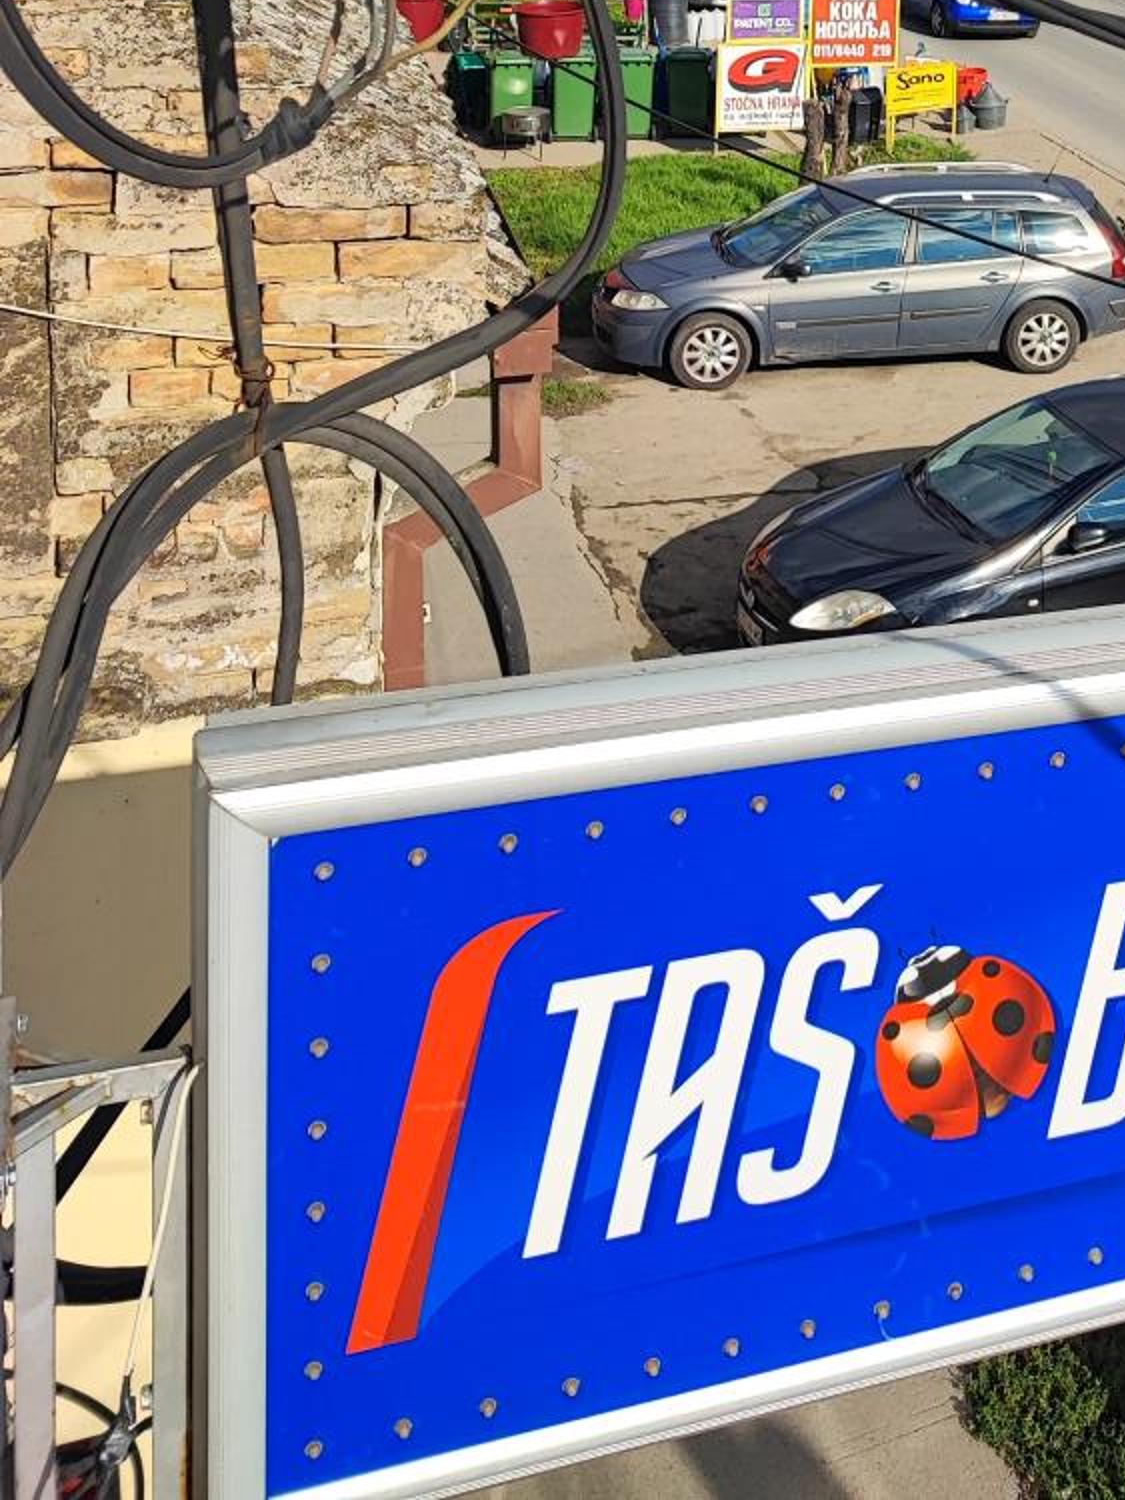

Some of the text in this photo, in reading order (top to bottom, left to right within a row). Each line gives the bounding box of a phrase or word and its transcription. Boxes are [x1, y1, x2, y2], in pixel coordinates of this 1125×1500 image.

[829, 0, 878, 21] КОКА
[733, 17, 773, 29] PATENT
[815, 20, 891, 39] НОСИЉА
[896, 71, 945, 91] Sano
[522, 883, 883, 1260] TAŠ
